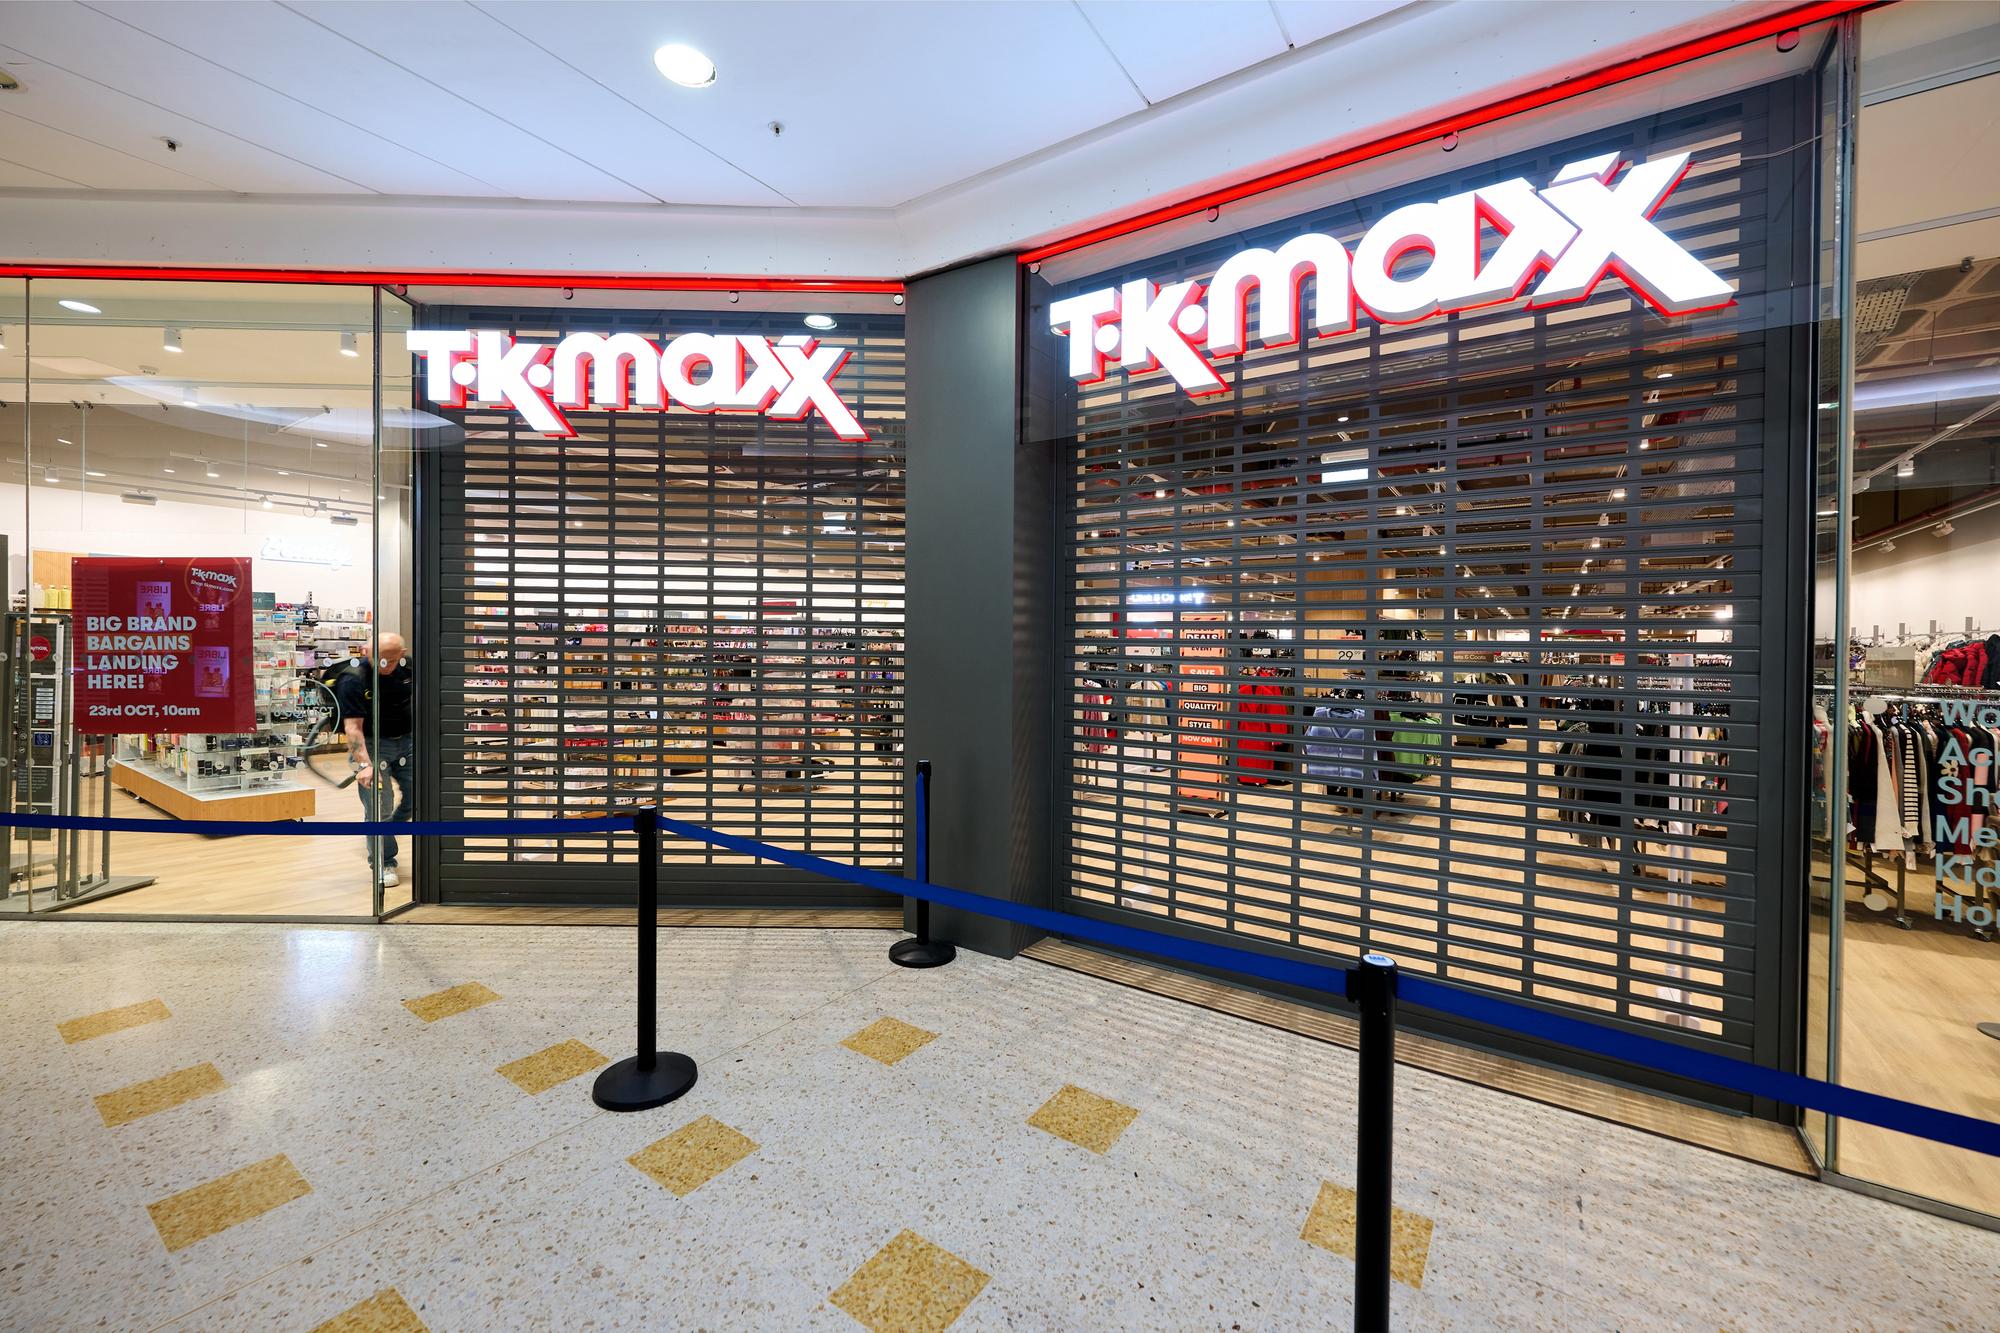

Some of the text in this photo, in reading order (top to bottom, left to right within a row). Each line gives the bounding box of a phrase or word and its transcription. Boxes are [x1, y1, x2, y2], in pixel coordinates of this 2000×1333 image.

[86, 616, 197, 632] BIG BRAND
[87, 635, 191, 651] BARGAINS
[87, 655, 179, 671] LANDING
[87, 674, 145, 689] HERE!
[1194, 684, 1208, 692] BIG
[89, 705, 200, 718] 23rd OCT, 10am
[1184, 702, 1217, 711] QUALITY
[1188, 721, 1212, 729] STYLE
[1938, 737, 2000, 767] Ac
[1937, 775, 2000, 806] Sh
[1935, 892, 2000, 928] Ho
